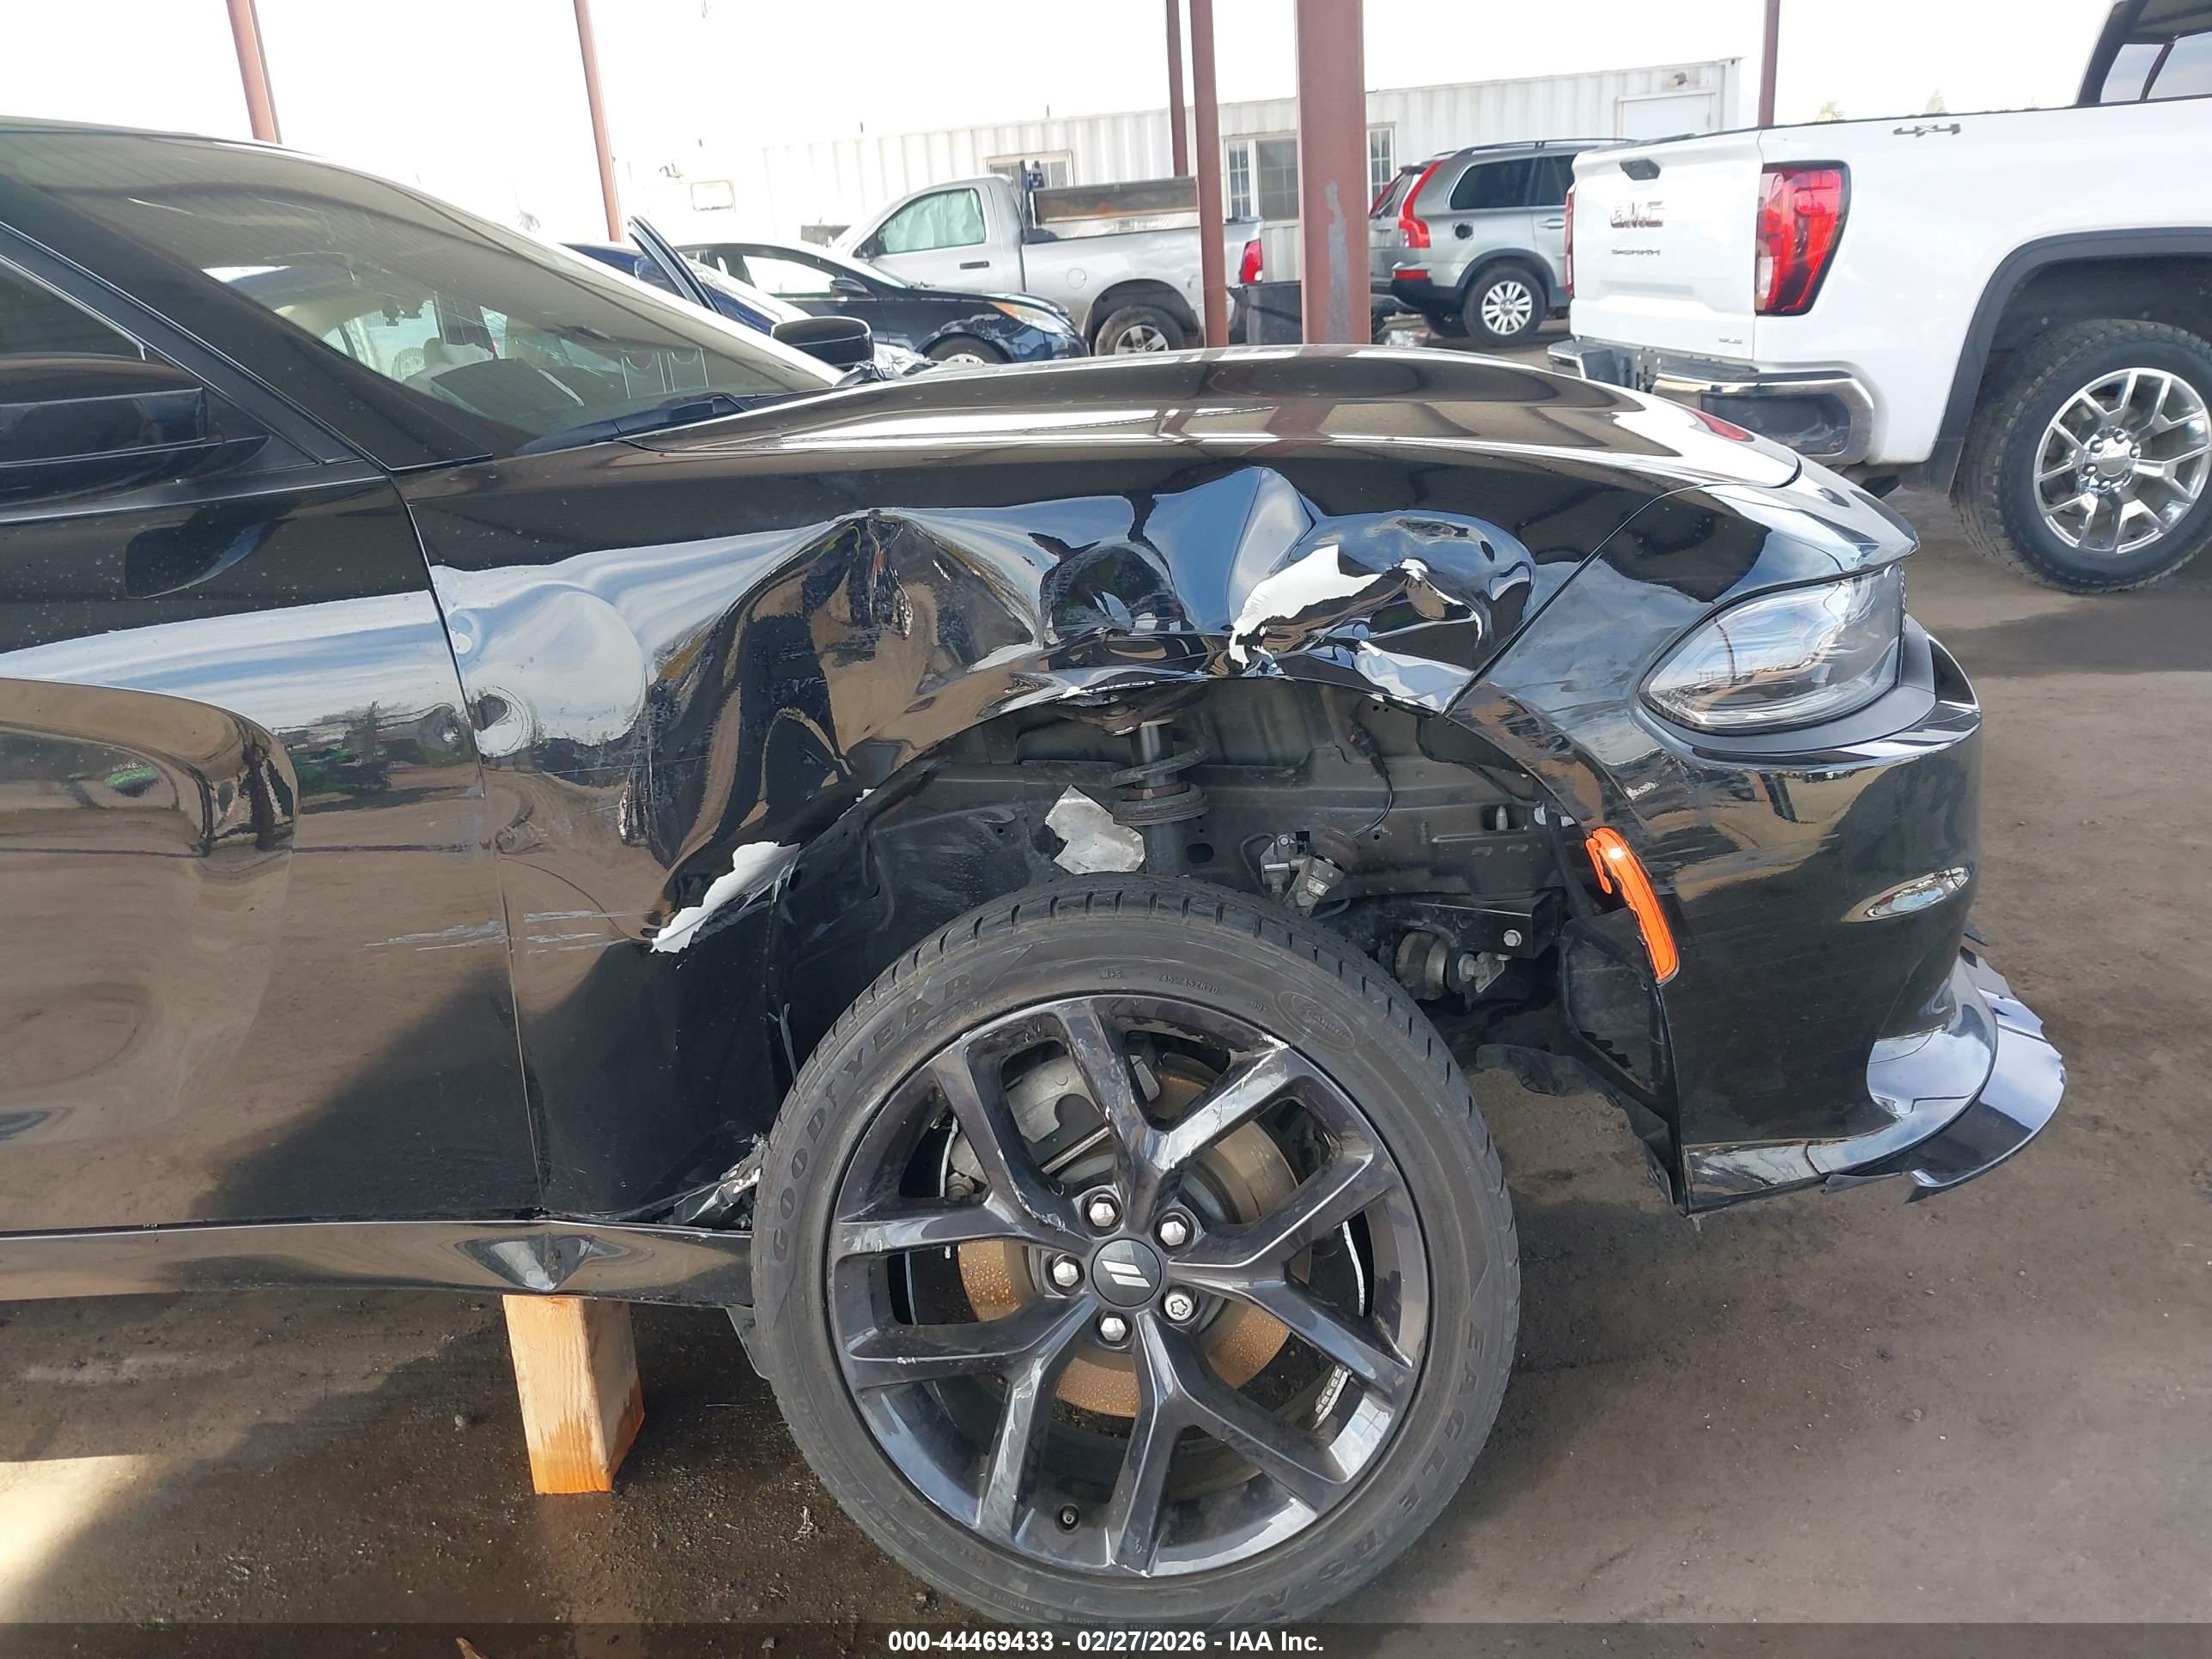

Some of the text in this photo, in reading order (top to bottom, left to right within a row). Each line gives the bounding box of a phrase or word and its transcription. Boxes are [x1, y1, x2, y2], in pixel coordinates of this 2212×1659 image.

[1610, 200, 1664, 228] GMC
[774, 974, 970, 1261] GOODYEAR
[1399, 1322, 1484, 1516] EAGLE
